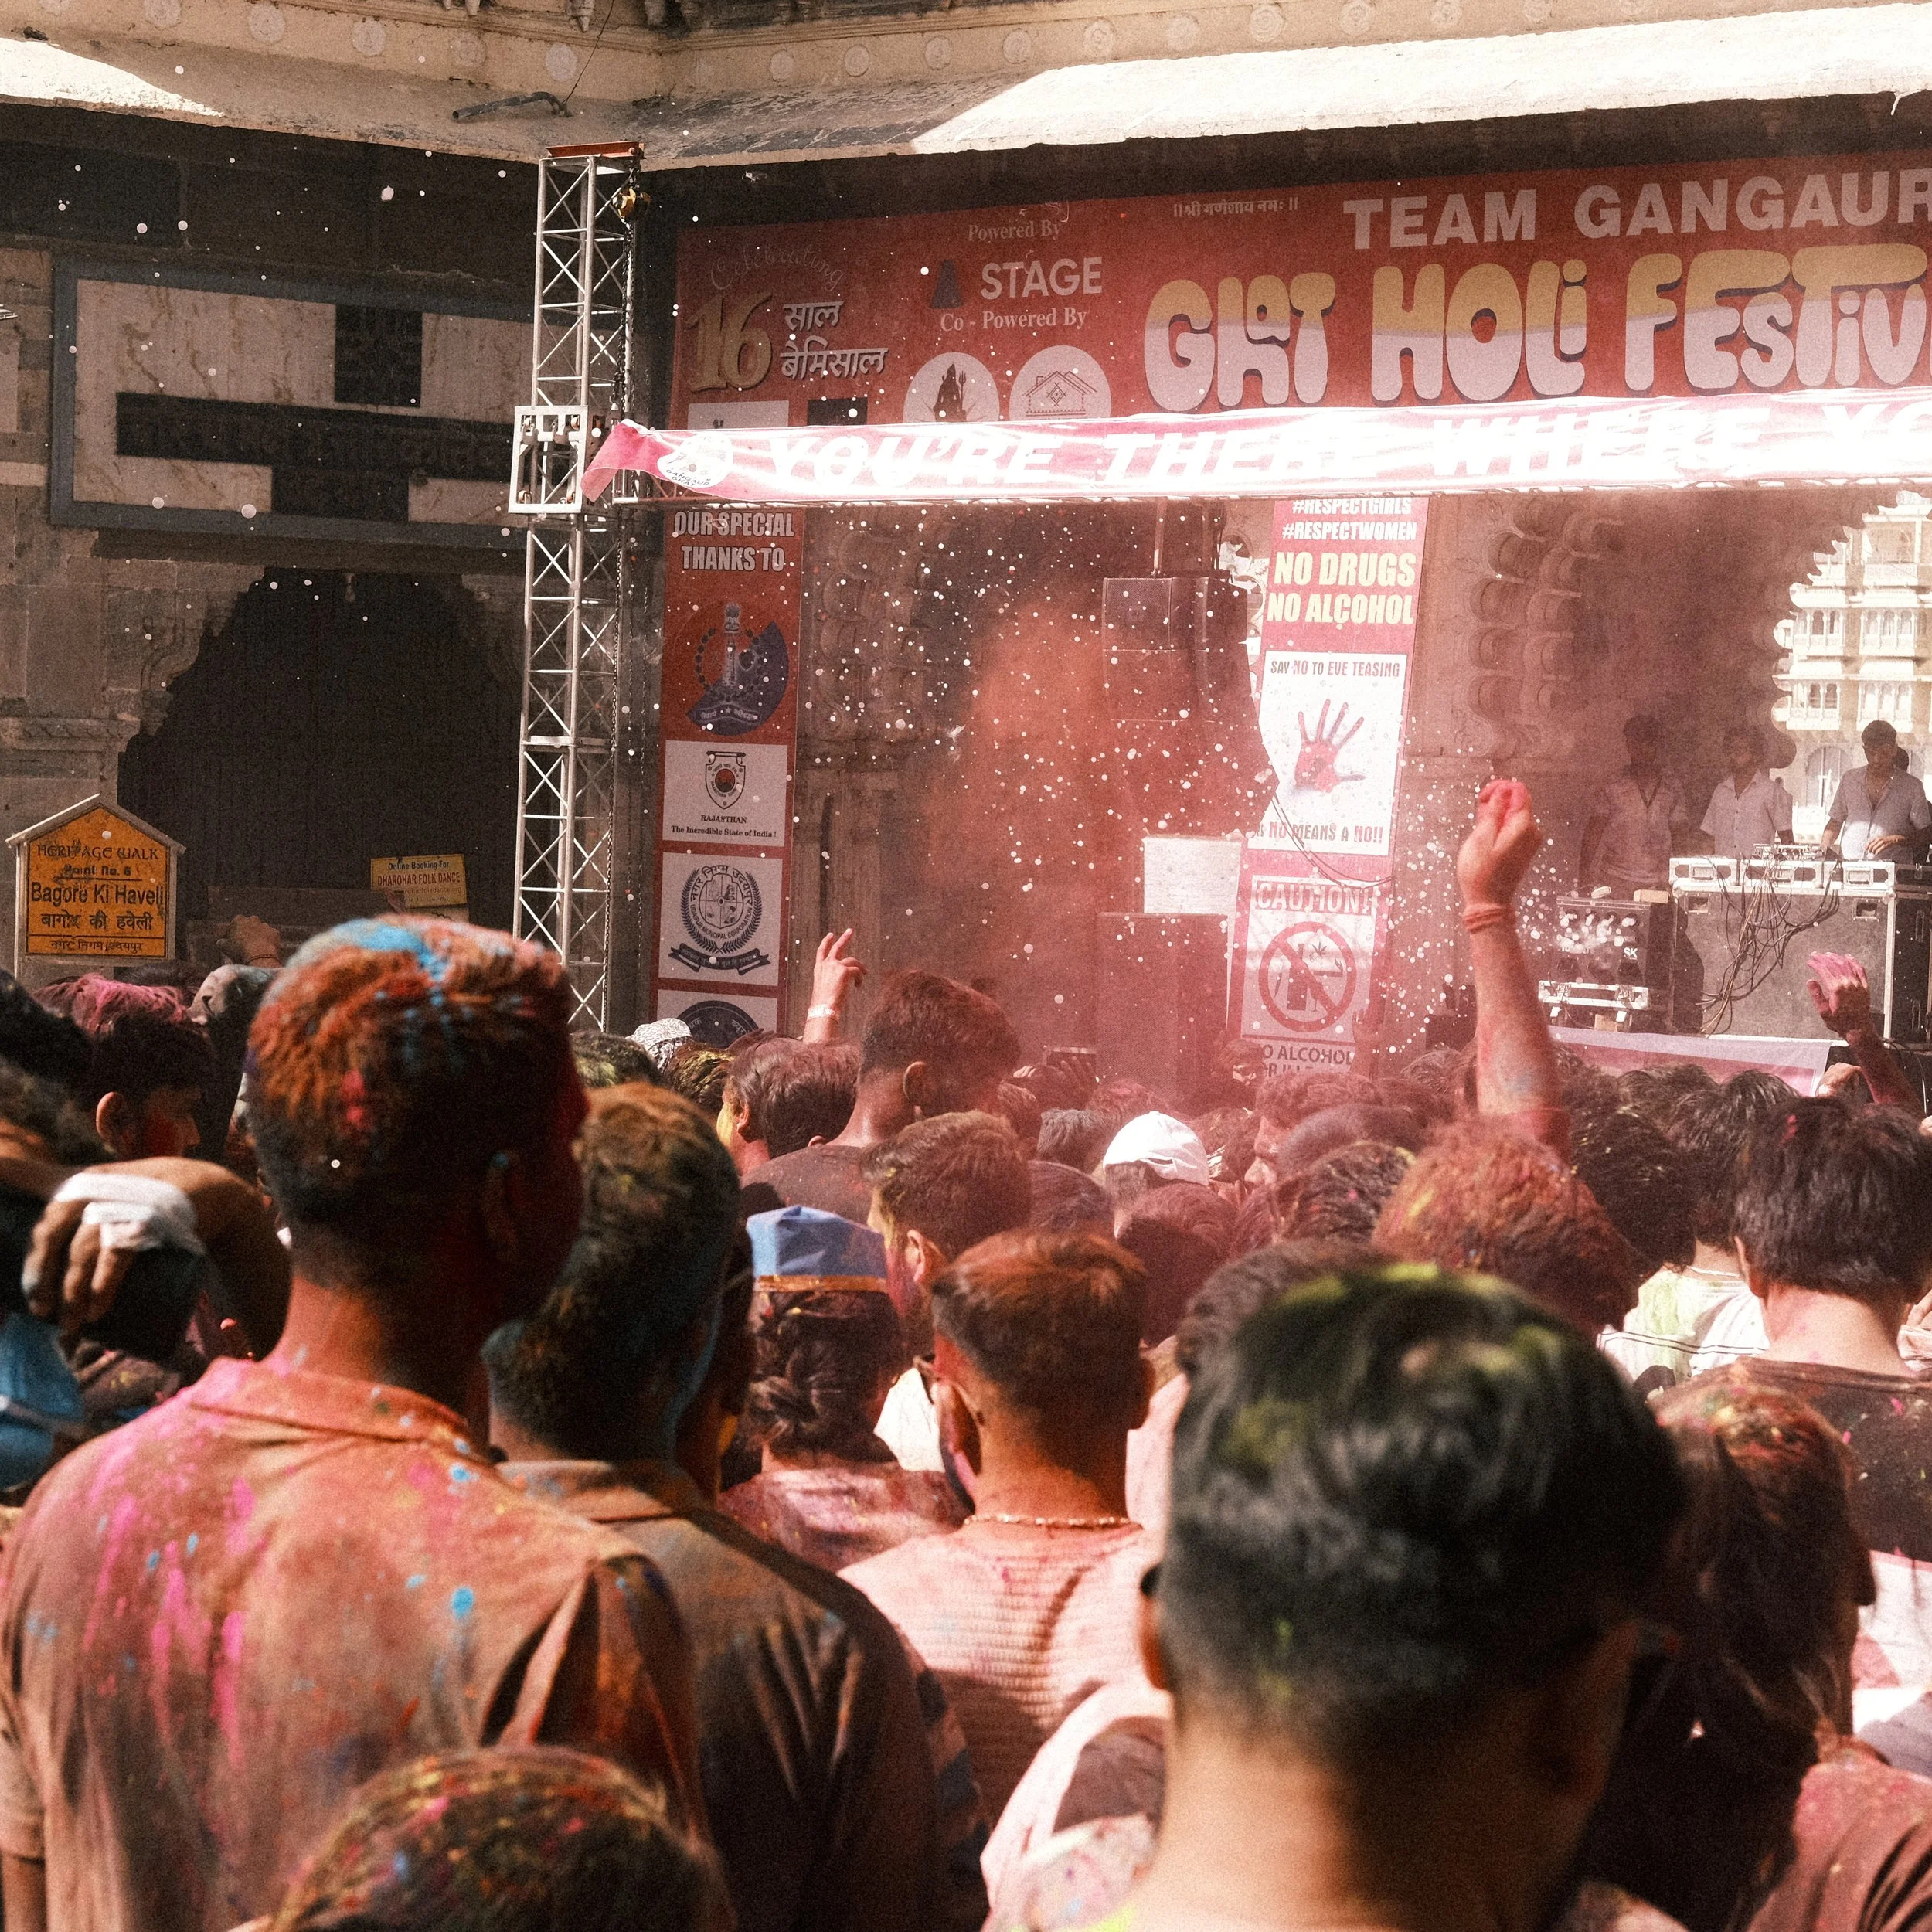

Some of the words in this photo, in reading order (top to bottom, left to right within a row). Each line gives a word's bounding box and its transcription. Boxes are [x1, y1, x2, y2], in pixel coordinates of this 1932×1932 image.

[1343, 189, 1537, 250] TEAM
[1574, 168, 1932, 240] GANGAUR
[968, 221, 1035, 241] Powered
[1041, 219, 1062, 240] By
[710, 243, 845, 292] Celebrating
[981, 257, 1103, 300] STAGE
[782, 301, 844, 332] साल
[940, 312, 964, 332] Co
[982, 308, 1056, 329] Powered
[1063, 307, 1087, 330] By
[686, 291, 774, 392] 16
[781, 335, 889, 380] बेमिसाल
[769, 434, 1065, 487] YOU'RE
[1433, 407, 1771, 476] WHERE
[1292, 498, 1412, 515] #RESPECTGIRLS
[674, 511, 713, 536] OUR
[717, 512, 794, 537] SPECIAL
[1282, 521, 1417, 541] #RESPECTWOMEN
[681, 545, 756, 571] THANKS
[760, 547, 786, 572] TO
[1274, 551, 1313, 586] NO
[1319, 552, 1417, 587] DRUGS
[1267, 593, 1301, 623] NO
[1304, 594, 1415, 624] ALCOHOL
[1270, 661, 1290, 674] SAY
[1293, 660, 1308, 675] NO
[1312, 662, 1324, 675] TO
[1352, 662, 1400, 677] TEASING
[686, 826, 723, 835] Incredible
[701, 815, 747, 824] RAJASTHAN
[1269, 821, 1287, 838] NO
[1292, 824, 1336, 841] MEANS
[1341, 827, 1349, 842] A
[1354, 826, 1383, 843] NO!!
[117, 849, 159, 859] WALK
[411, 861, 437, 870] Booking
[377, 873, 417, 886] DHAROHAR
[418, 873, 437, 884] FOLK
[438, 872, 460, 883] DANCE
[690, 877, 703, 902] नगर
[732, 868, 753, 906] उदयपुर
[31, 882, 88, 906] Bagore
[94, 883, 108, 903] Ki
[115, 885, 164, 905] Haveli
[117, 911, 153, 930] हवेली
[690, 904, 703, 927] UDAIPUR
[701, 927, 727, 939] MUNICIPAL
[727, 907, 753, 939] CORPORATION
[1623, 947, 1638, 957] SK
[1277, 1046, 1353, 1065] ALCOHOL
